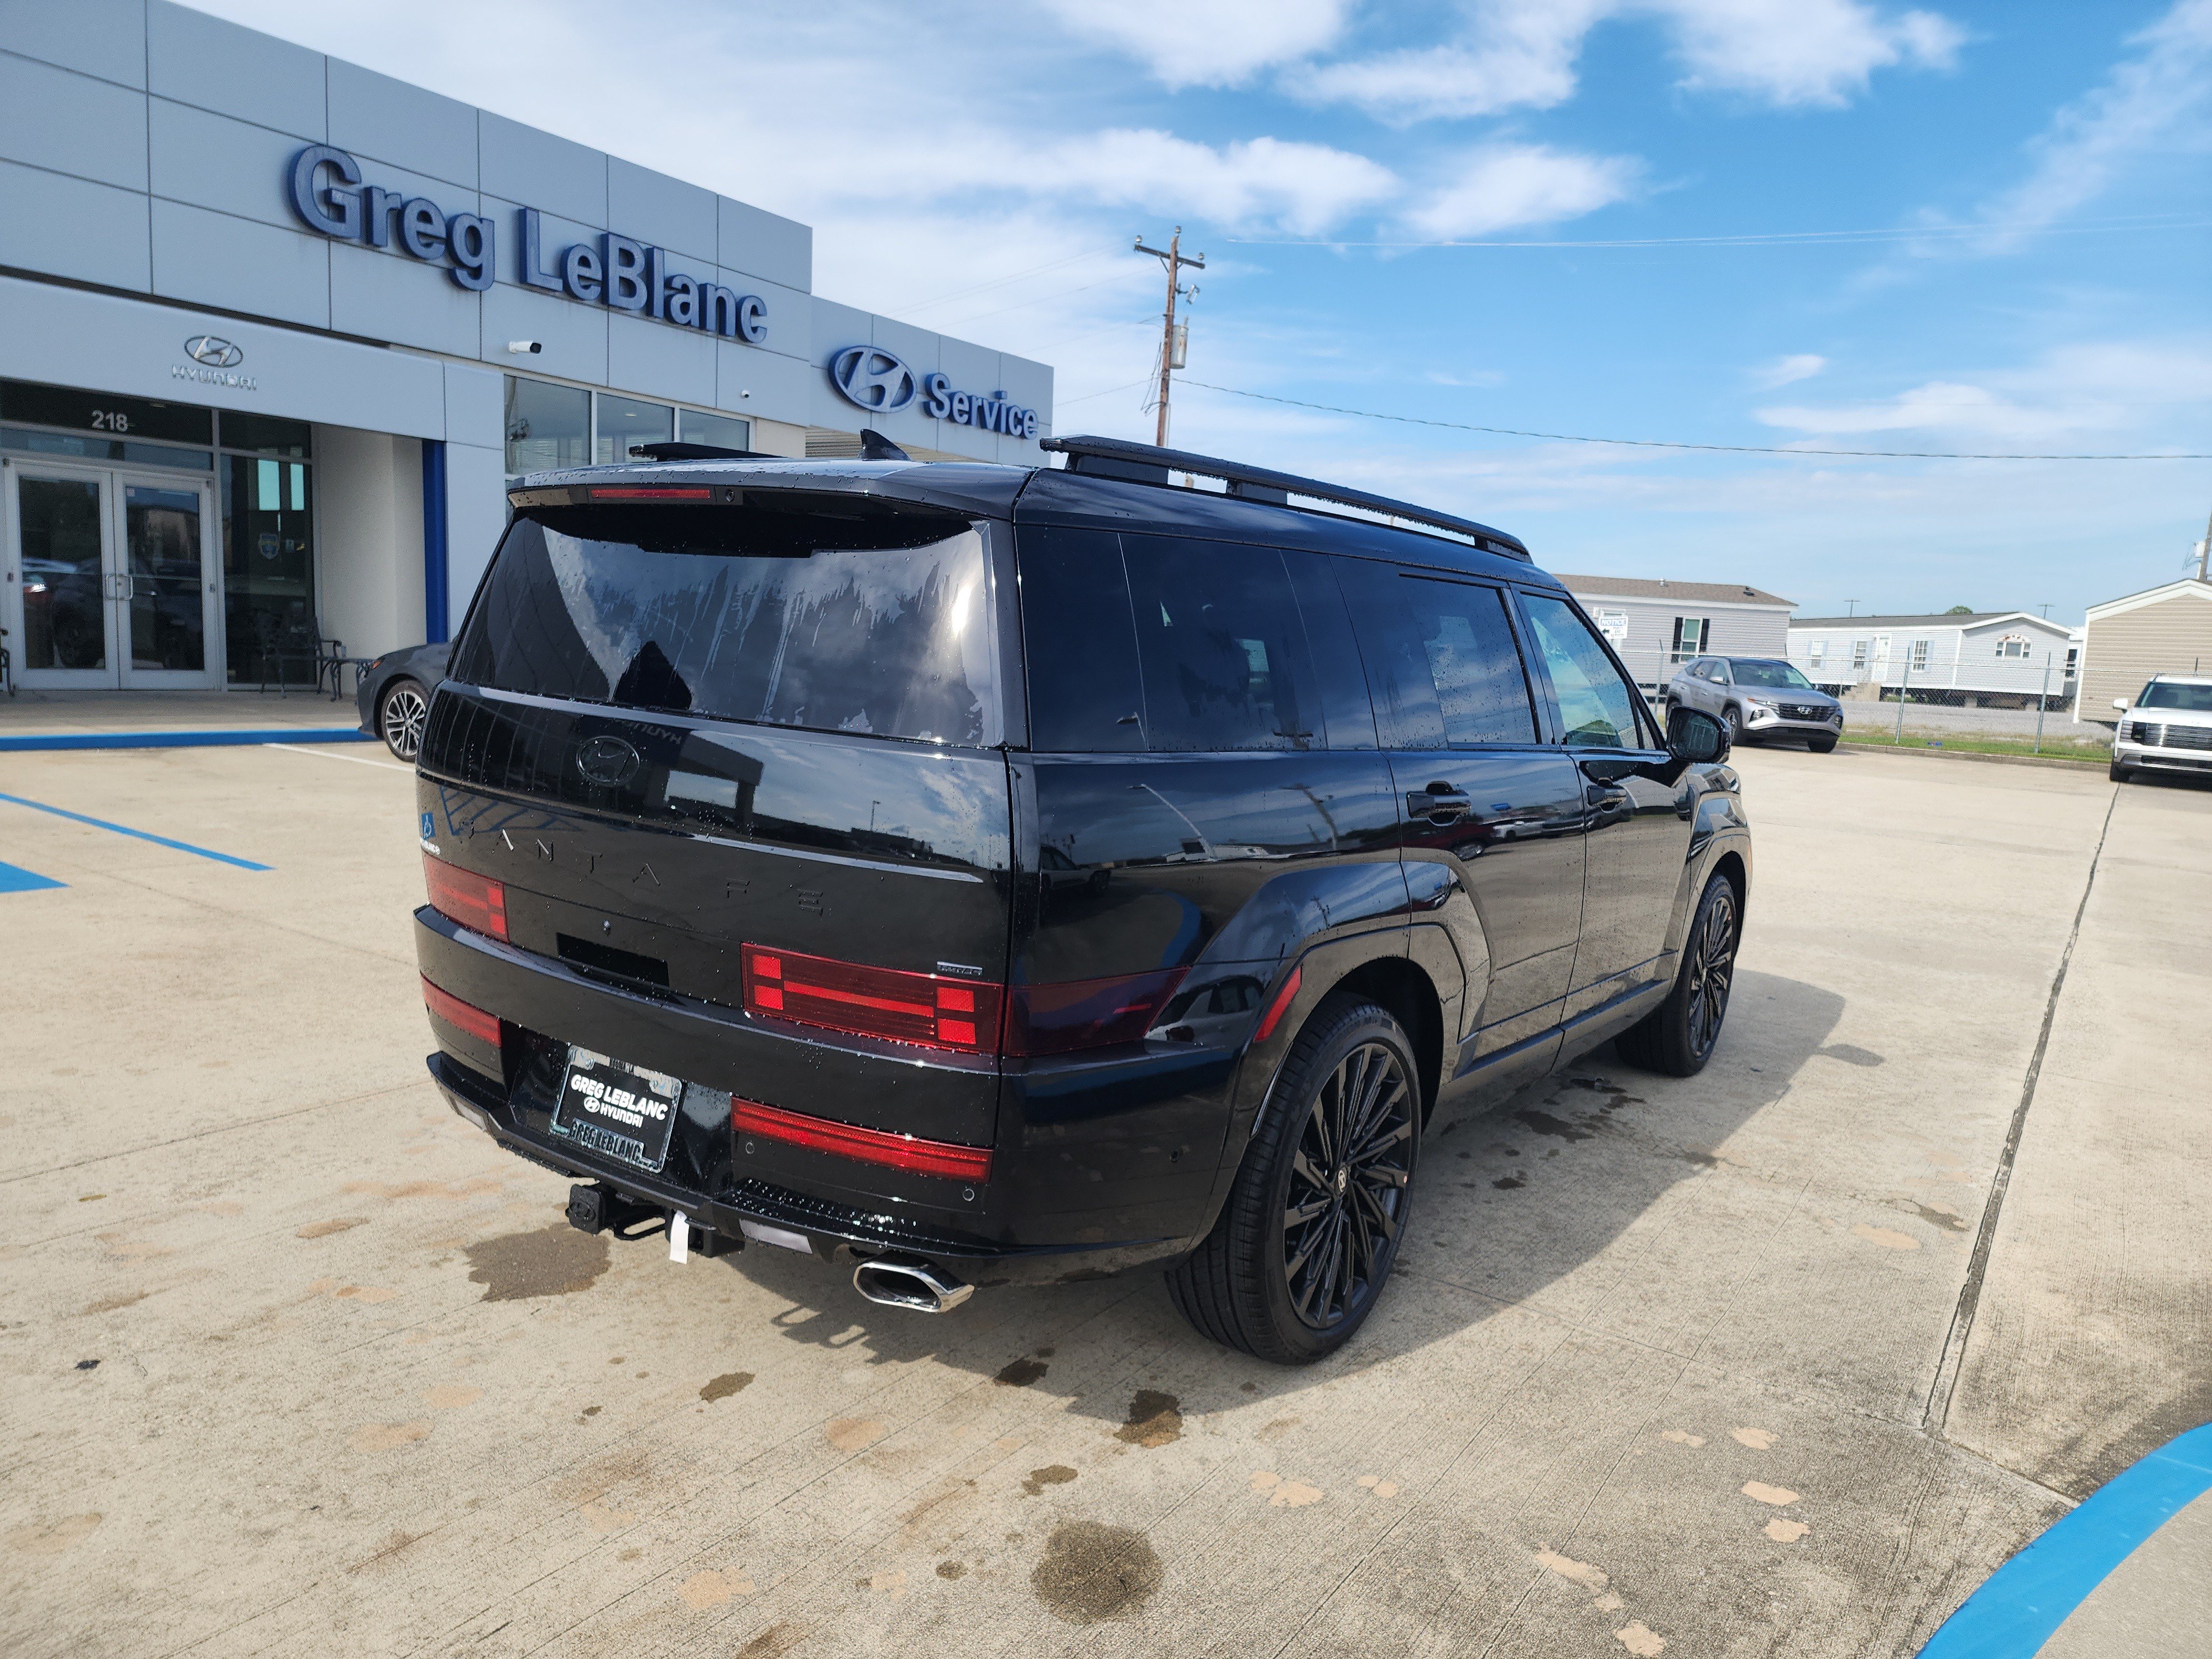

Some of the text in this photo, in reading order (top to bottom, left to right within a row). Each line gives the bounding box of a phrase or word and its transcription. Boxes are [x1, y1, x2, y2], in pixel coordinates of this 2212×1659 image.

[287, 145, 768, 343] Greg LeBlanc
[172, 364, 257, 390] HYUNDAI
[91, 410, 128, 431] 218
[924, 373, 1039, 440] Service
[571, 1074, 668, 1121] GREG LEBLANC
[599, 1102, 644, 1128] HYUNDAI
